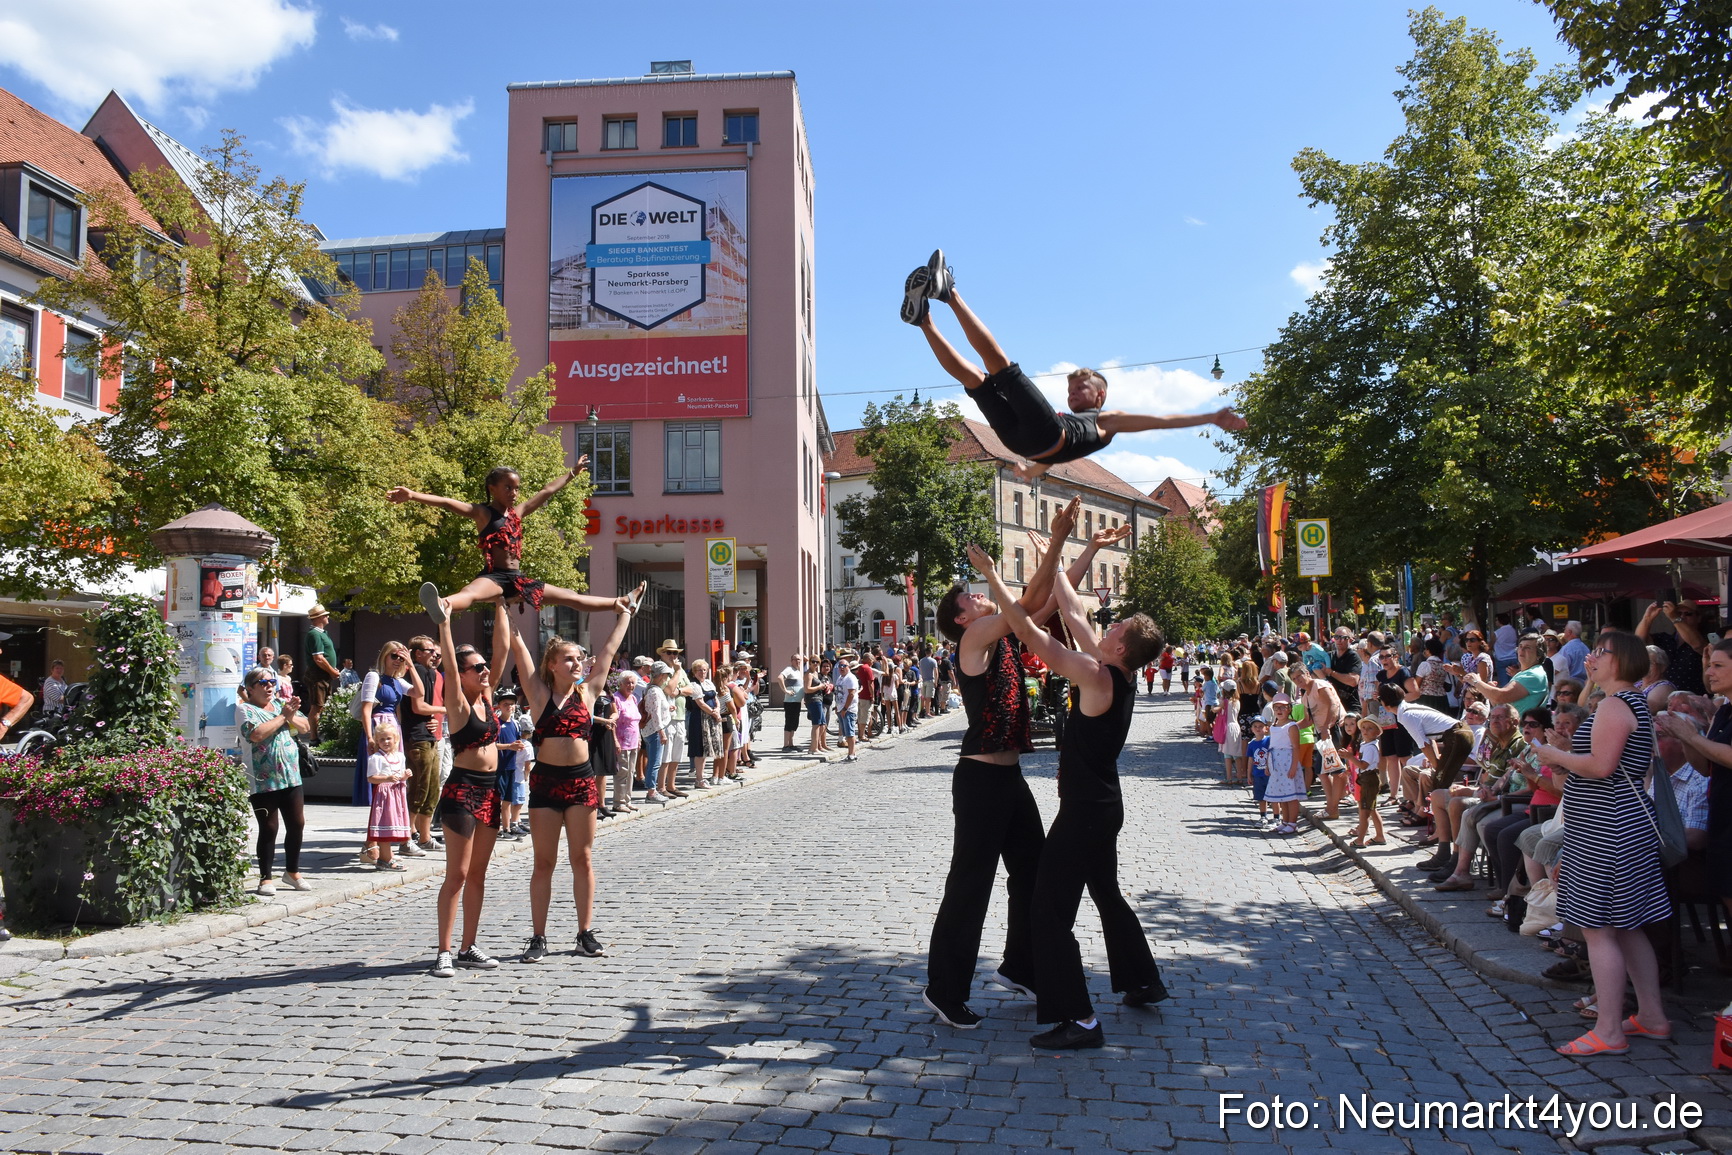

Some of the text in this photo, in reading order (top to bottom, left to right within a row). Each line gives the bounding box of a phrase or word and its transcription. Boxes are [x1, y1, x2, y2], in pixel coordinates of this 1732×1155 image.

[599, 213, 628, 226] DIE
[637, 245, 689, 254] BANKENTEST
[596, 253, 700, 264] Beratung Baufinanzierung
[627, 270, 670, 279] Sparkasse
[607, 278, 689, 288] Neumarkt-Parsberg
[568, 355, 728, 382] Ausgezeichnet!
[615, 514, 725, 539] Sparkasse
[220, 571, 244, 579] BOXEN
